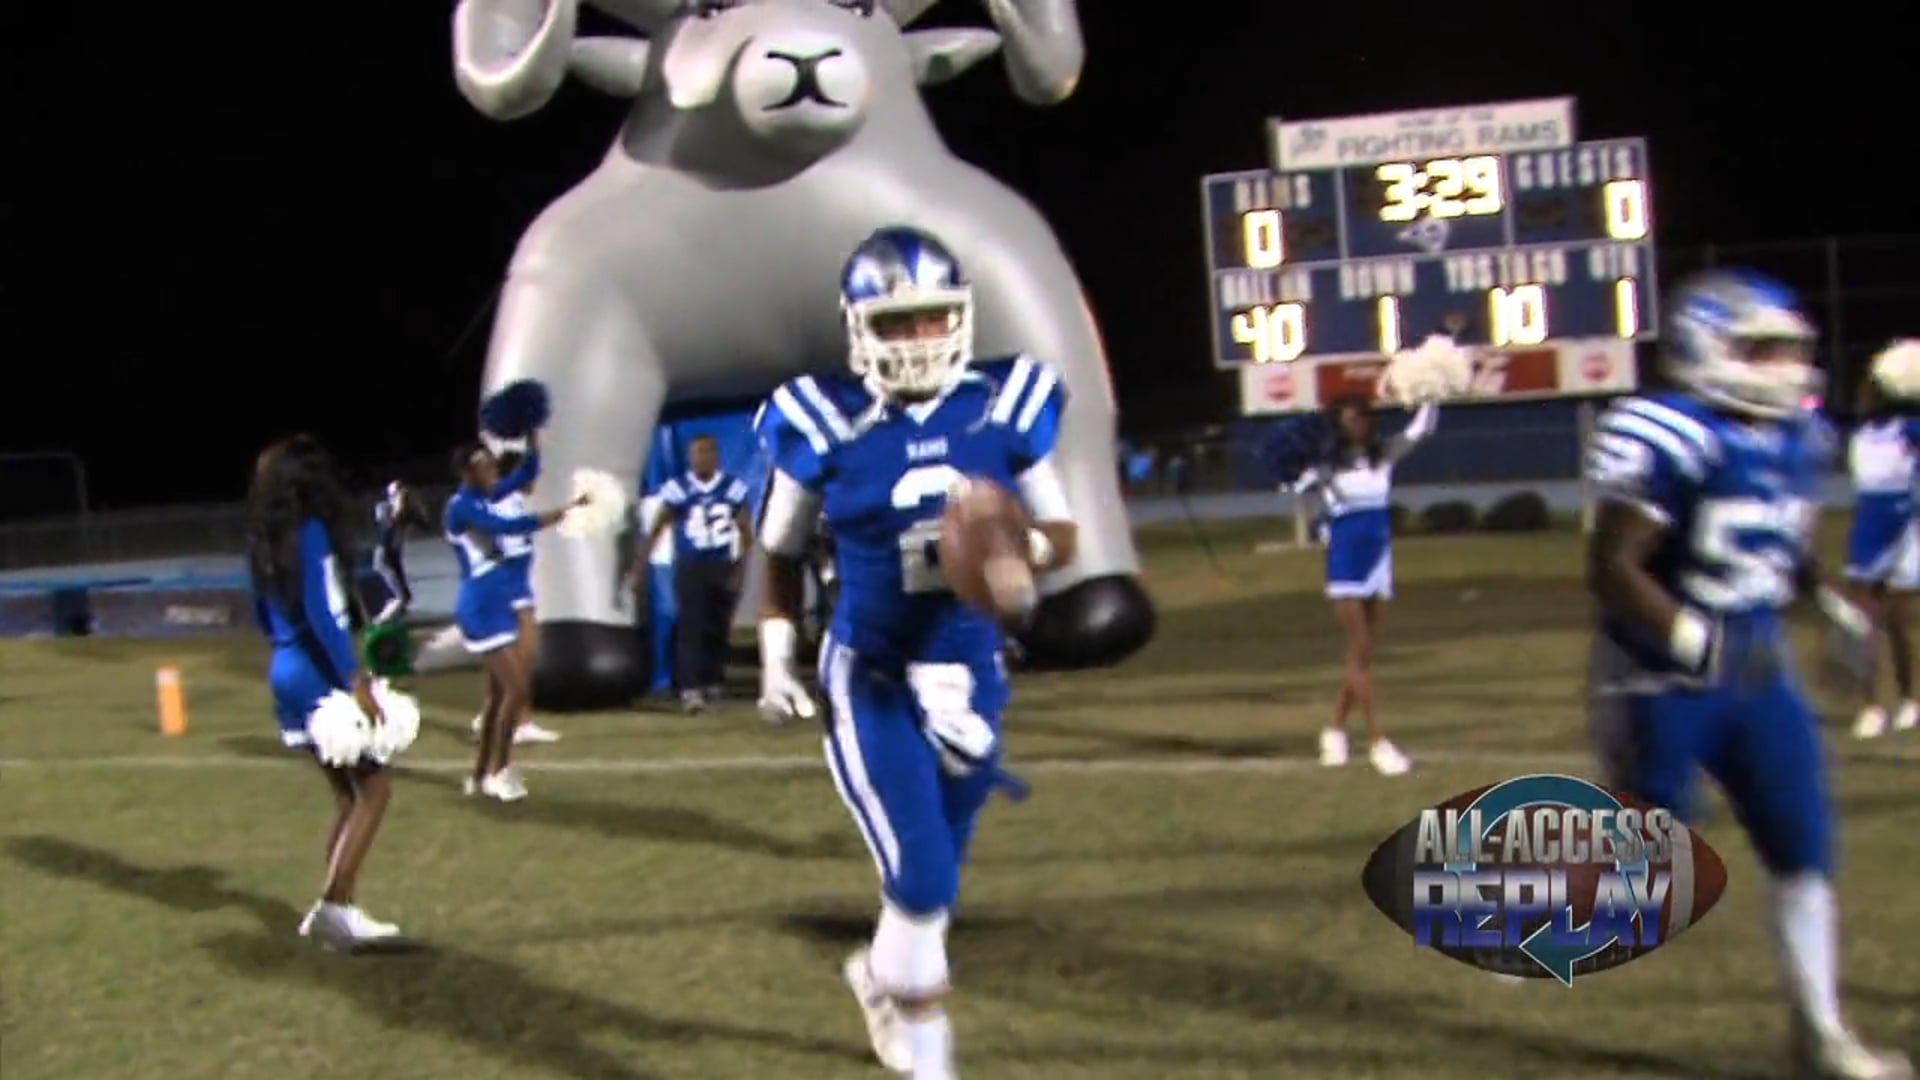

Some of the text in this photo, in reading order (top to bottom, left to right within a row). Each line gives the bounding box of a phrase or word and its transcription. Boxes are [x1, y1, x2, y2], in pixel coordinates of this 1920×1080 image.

[1337, 120, 1558, 158] FIGHTING RAMS
[1374, 155, 1504, 222] 3:29
[1604, 178, 1647, 240] 0
[1243, 209, 1284, 268] 0
[1231, 302, 1307, 363] 40
[1378, 295, 1400, 354] 1
[1488, 282, 1549, 347] 10
[1615, 276, 1637, 338] 1
[684, 503, 740, 550] 42
